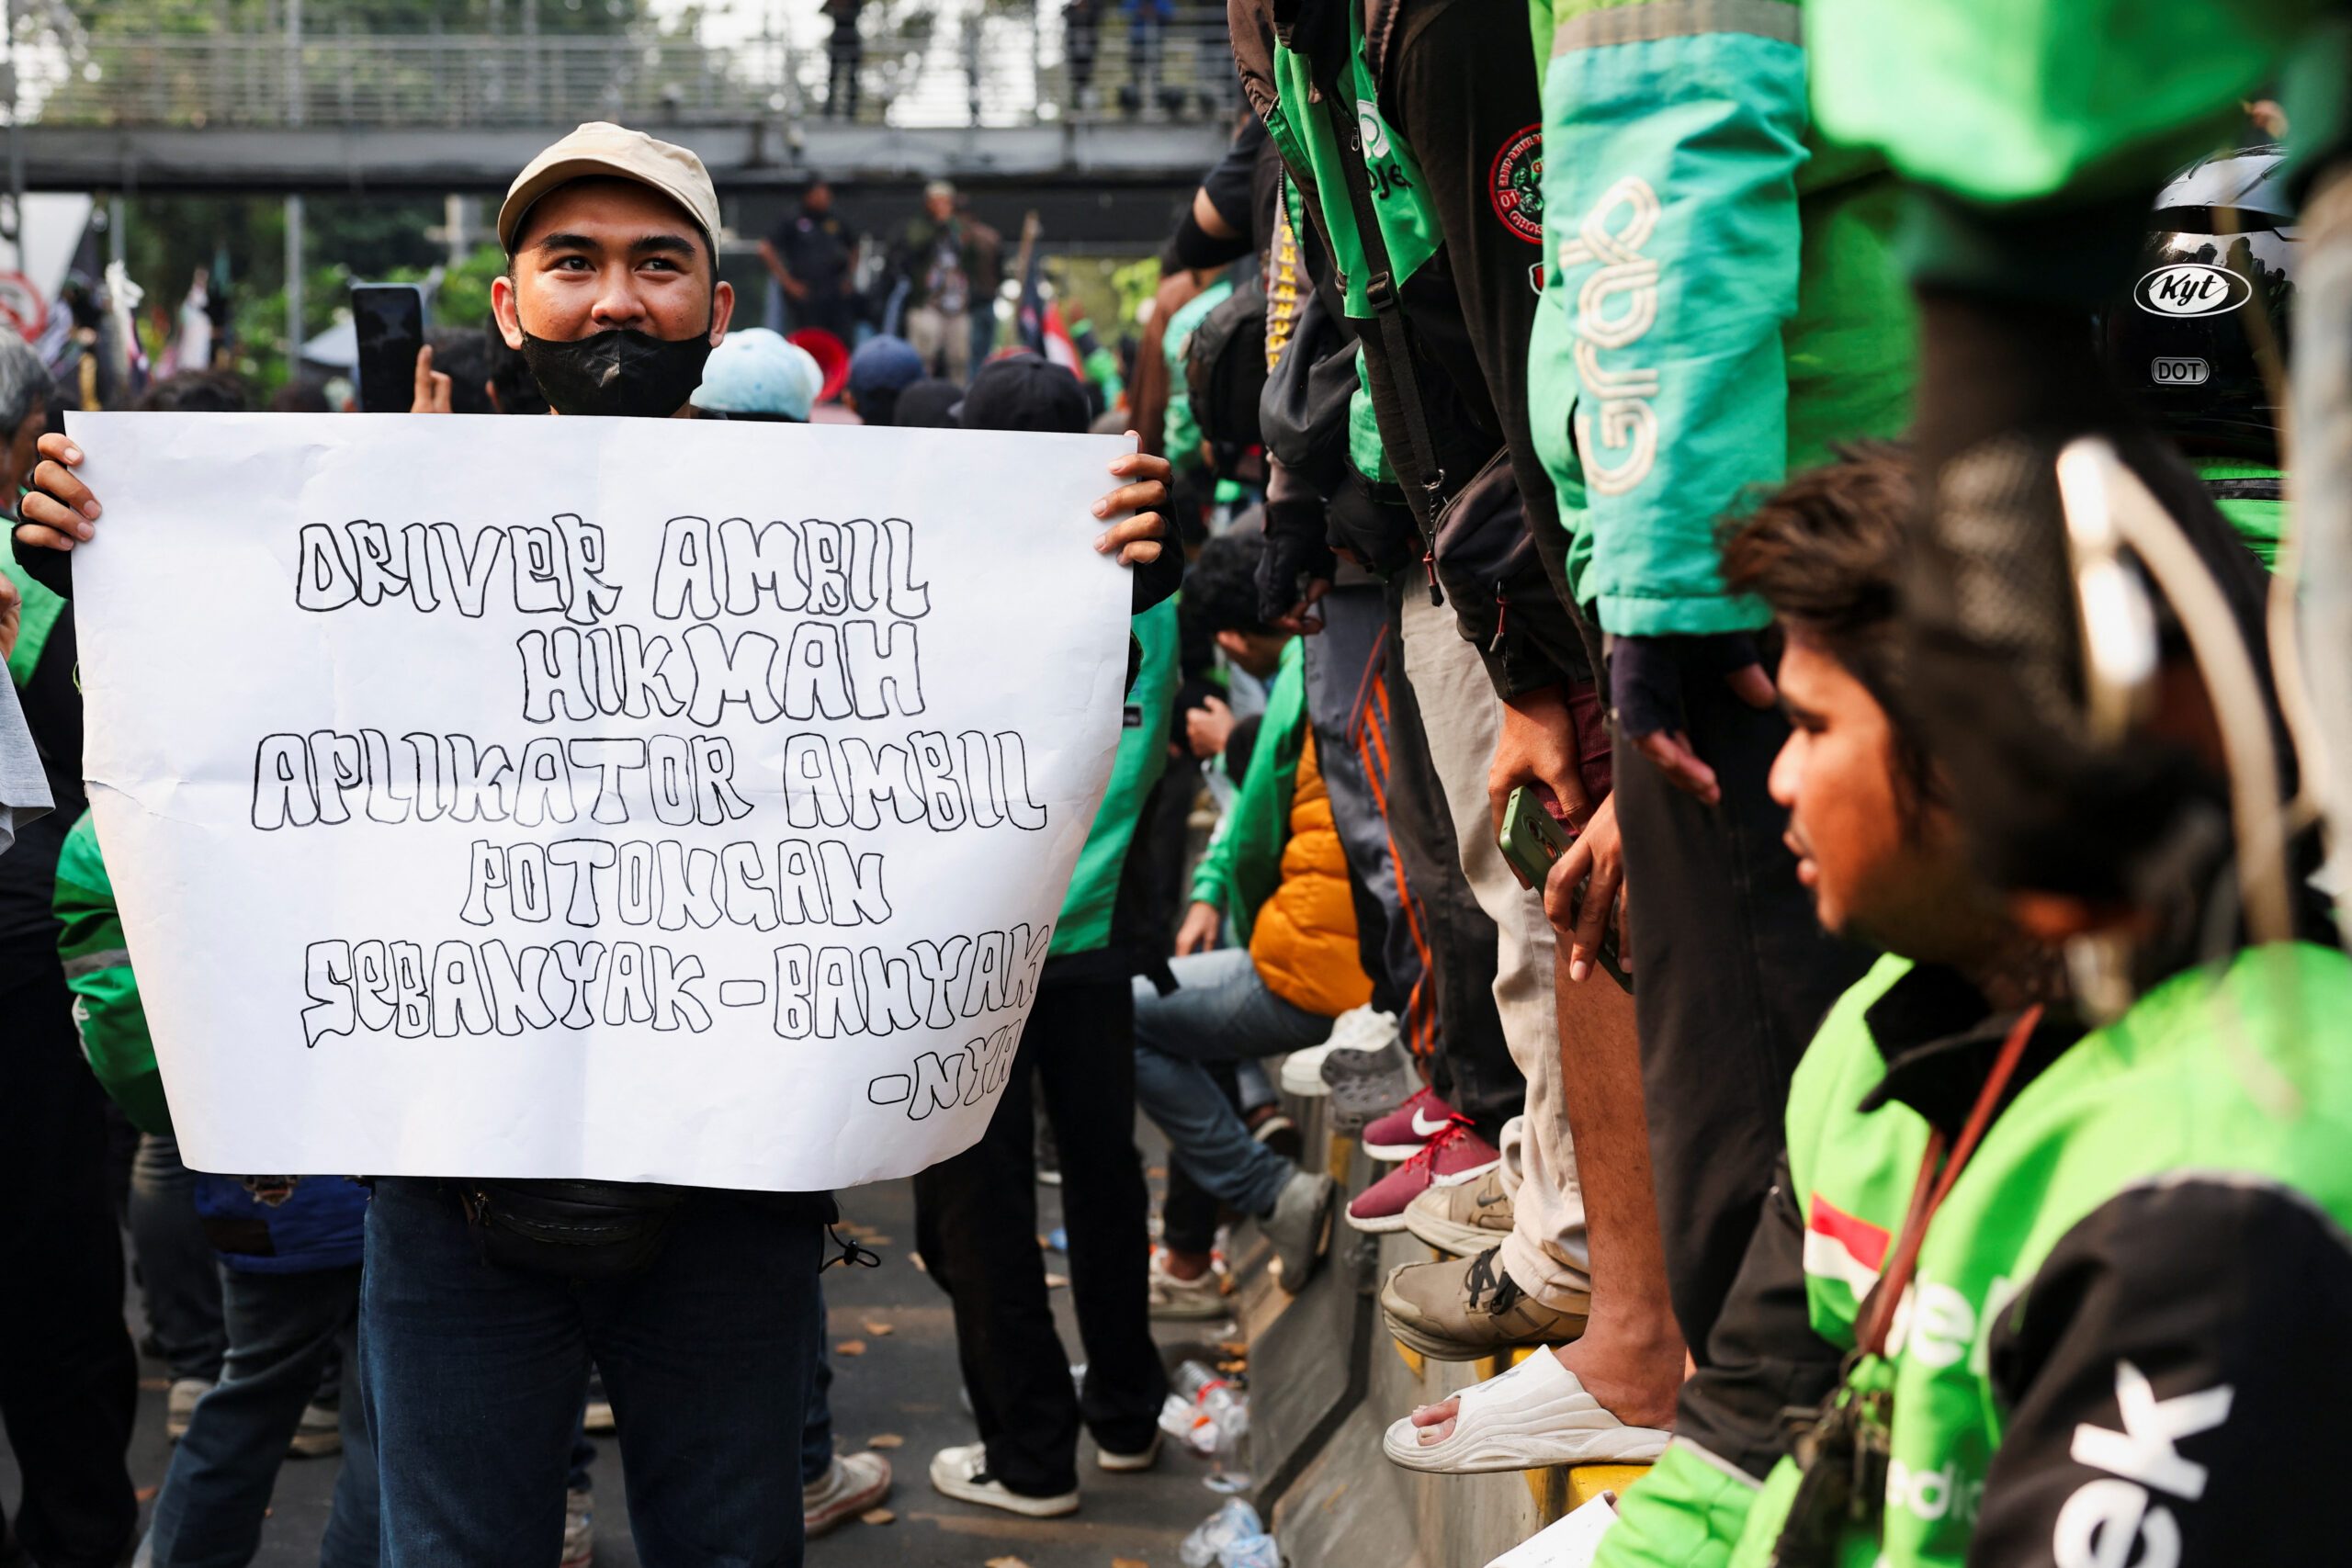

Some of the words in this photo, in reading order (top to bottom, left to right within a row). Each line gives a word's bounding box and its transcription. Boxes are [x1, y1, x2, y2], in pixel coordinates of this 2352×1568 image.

[1500, 191, 1519, 208] 01
[1558, 175, 1660, 497] Grab
[2158, 362, 2201, 380] DOT
[653, 515, 932, 621] AMBIL
[516, 620, 925, 728] HIKMAH
[252, 728, 754, 831] APLIKATOR
[783, 730, 1047, 832] AMBIL
[459, 838, 892, 932] POTONGAN
